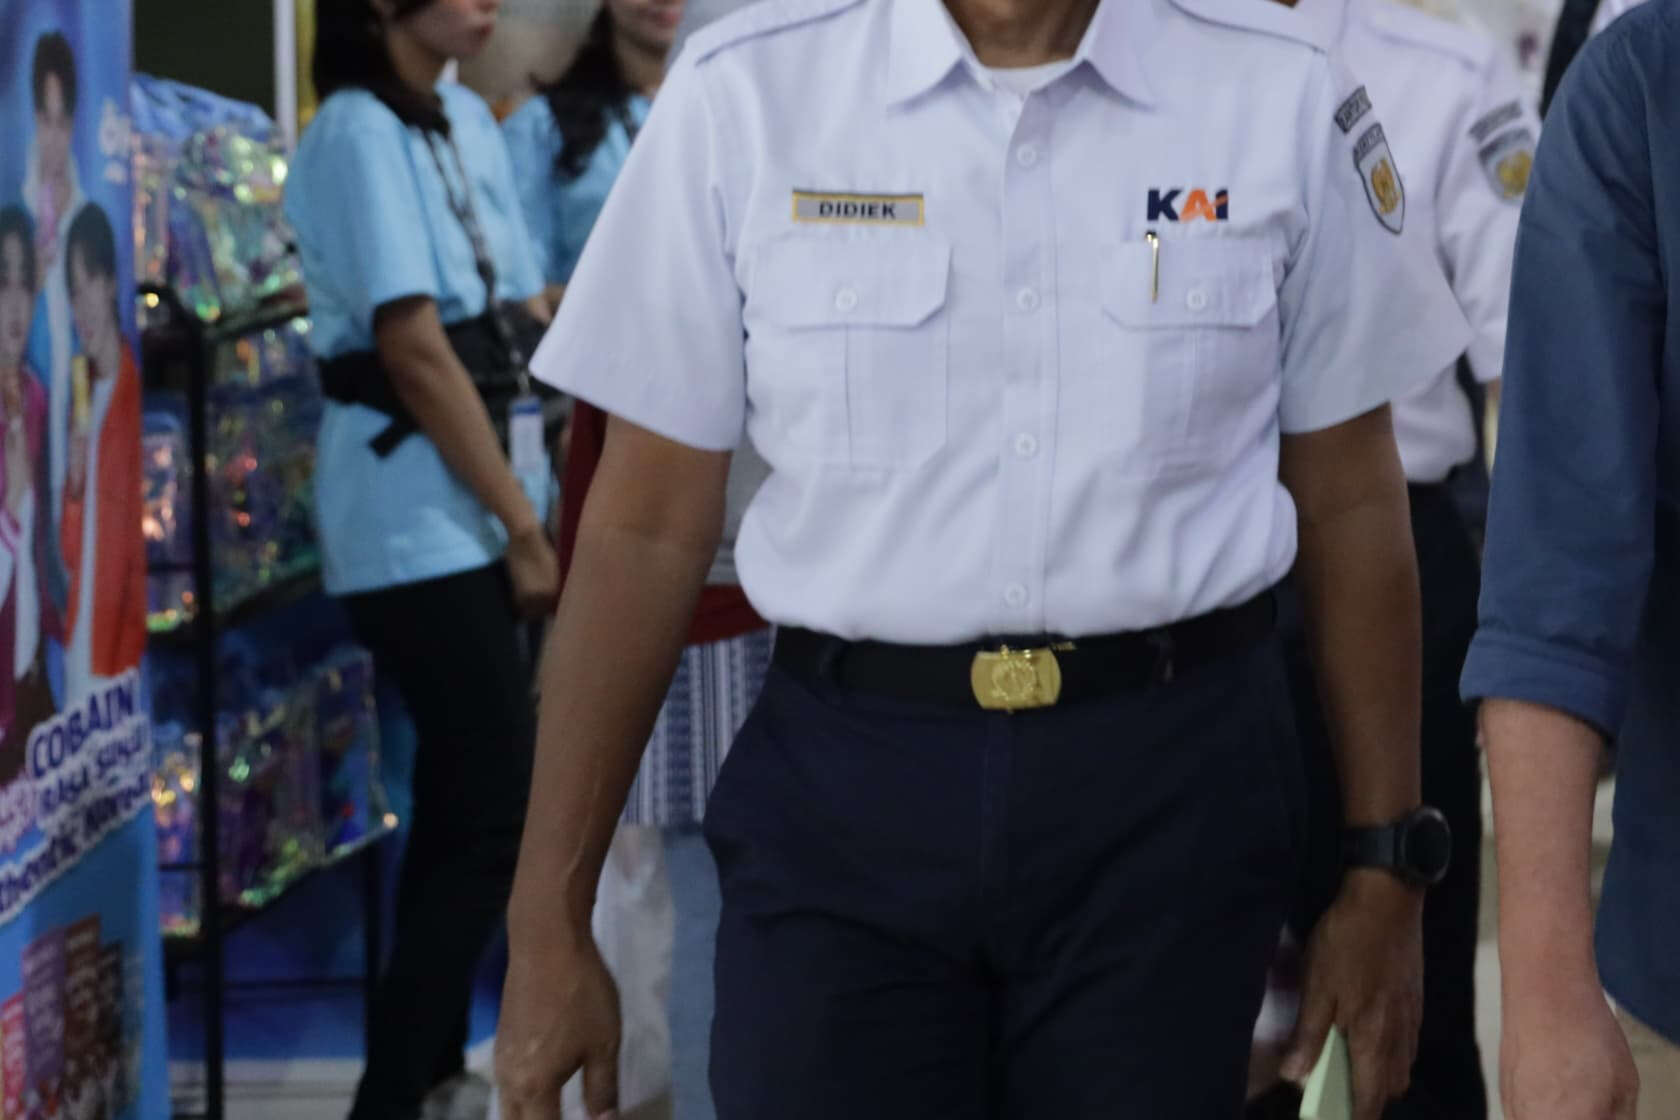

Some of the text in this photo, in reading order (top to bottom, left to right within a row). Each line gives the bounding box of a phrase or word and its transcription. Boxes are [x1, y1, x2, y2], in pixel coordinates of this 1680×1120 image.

[819, 200, 896, 220] DIDIEK
[1147, 188, 1229, 223] KAI
[32, 677, 135, 779] COBAIN
